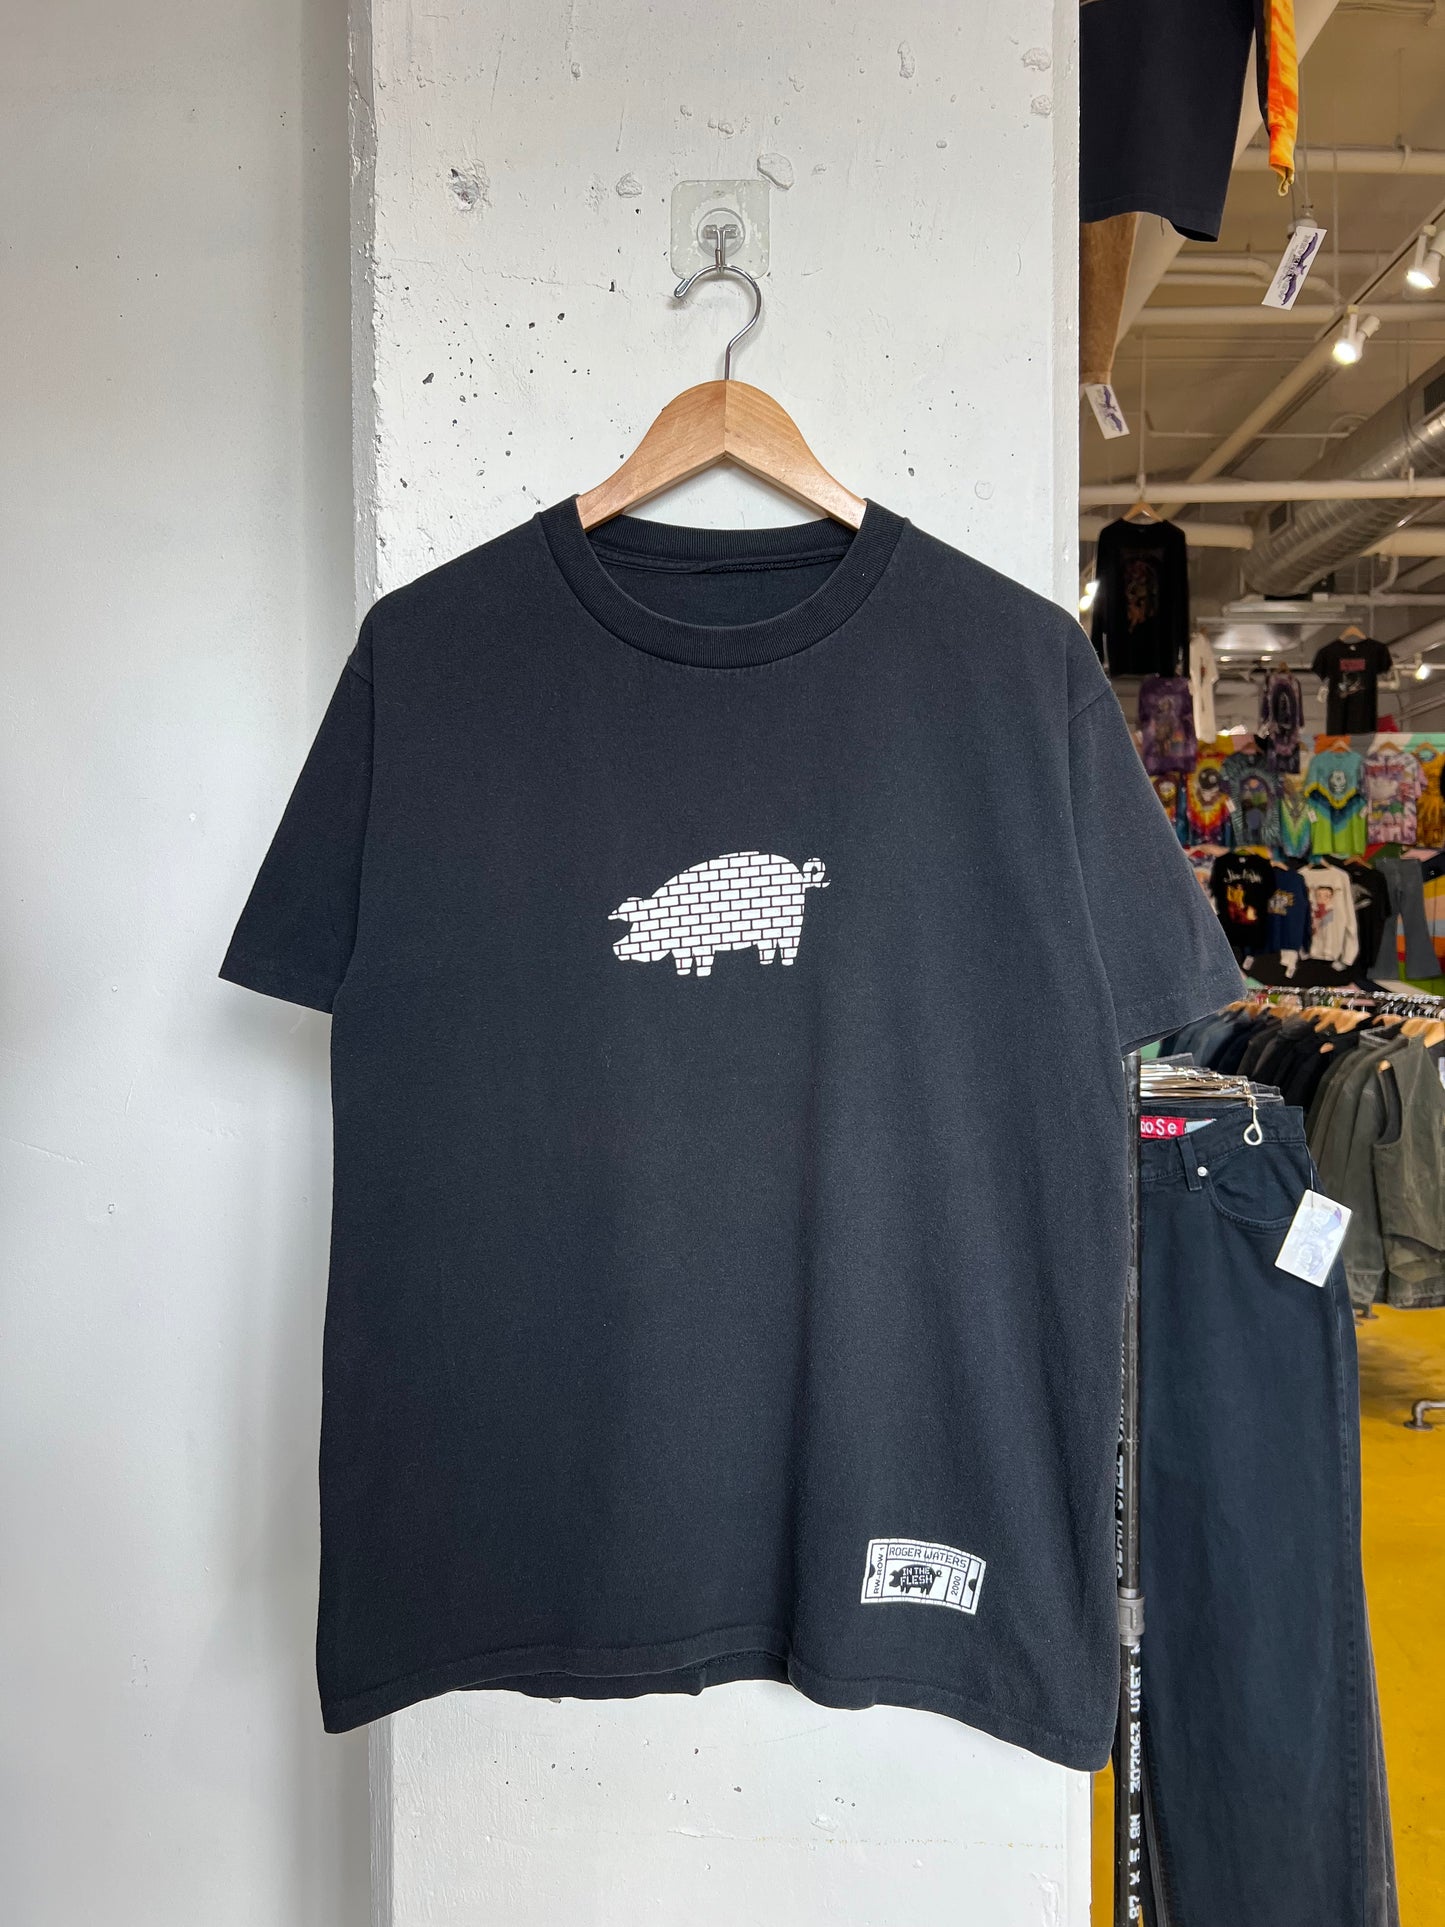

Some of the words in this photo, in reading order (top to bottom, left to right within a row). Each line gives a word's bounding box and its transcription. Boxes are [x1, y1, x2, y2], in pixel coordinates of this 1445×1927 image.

[888, 1547, 922, 1558] ROGER
[924, 1549, 968, 1569] WATERS
[873, 1553, 885, 1594] RW-ROW
[900, 1574, 932, 1586] FLESH
[902, 1567, 913, 1576] IN
[913, 1567, 930, 1575] THE
[950, 1575, 961, 1596] 2000
